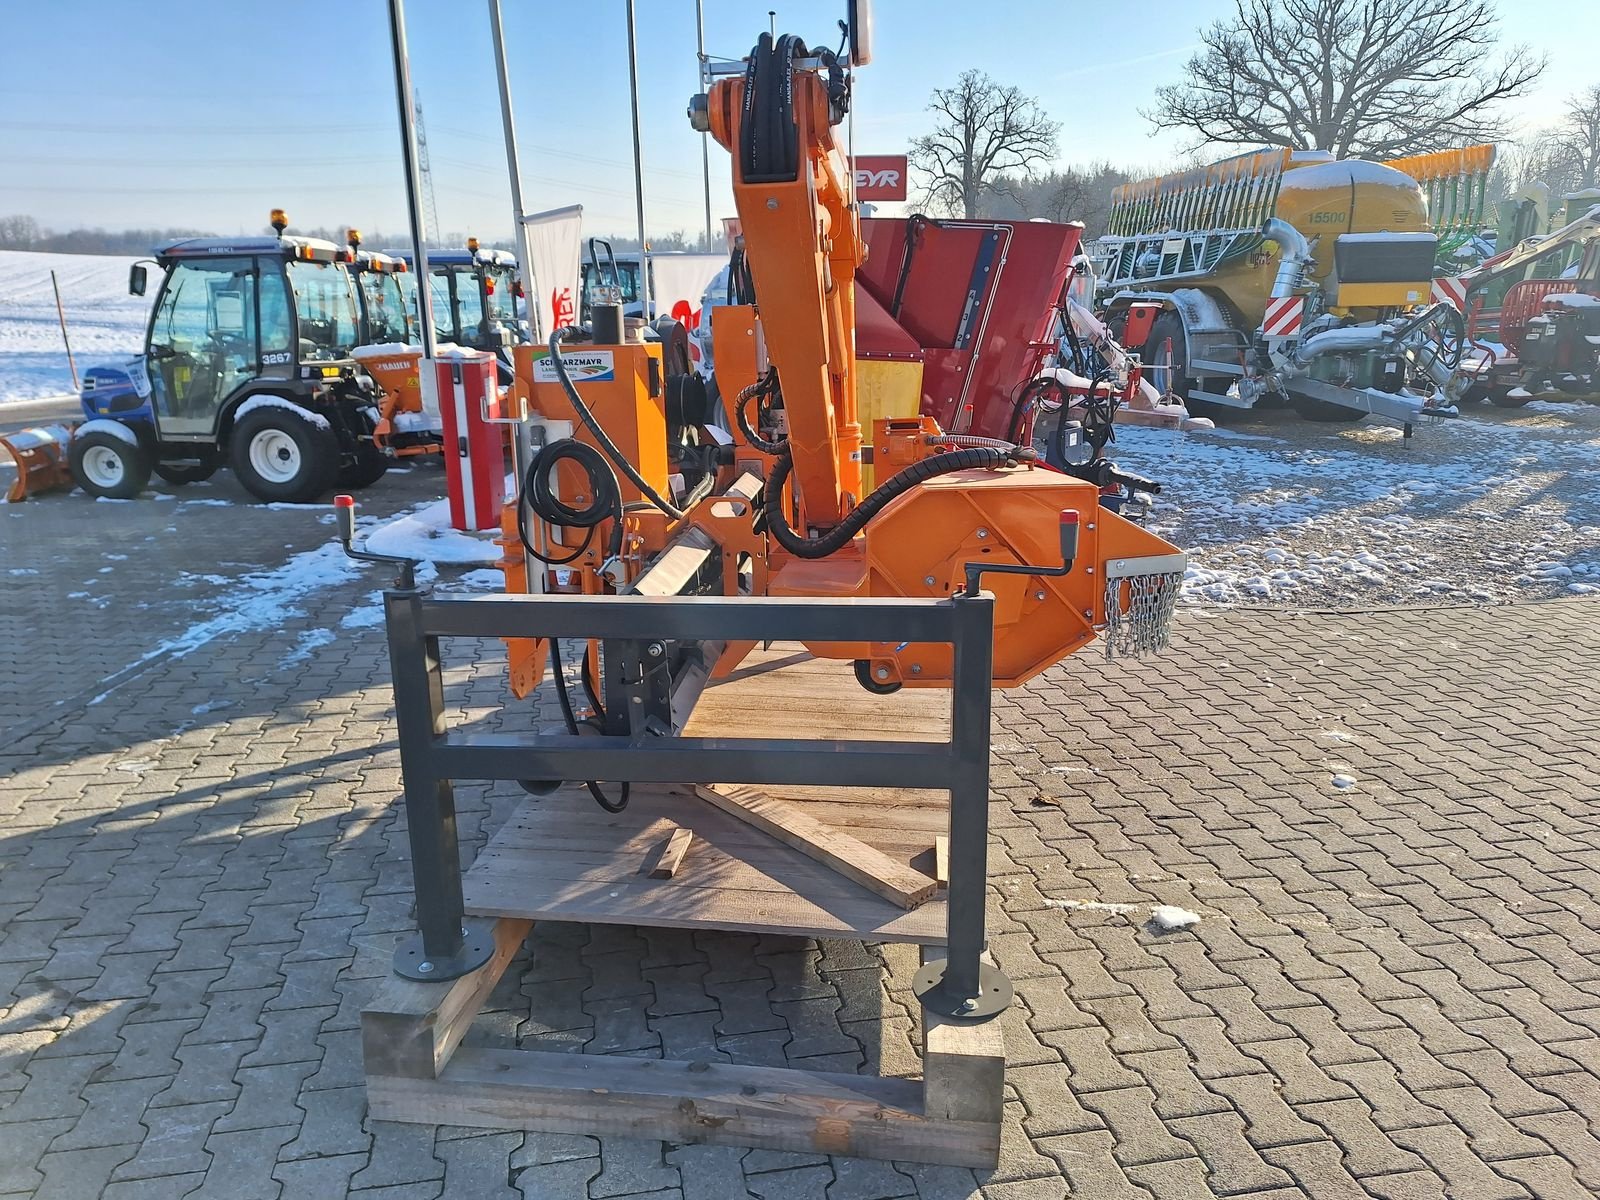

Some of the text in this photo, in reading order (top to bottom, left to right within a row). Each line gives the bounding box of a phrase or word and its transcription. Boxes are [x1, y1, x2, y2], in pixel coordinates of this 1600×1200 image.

[855, 169, 900, 188] EYR
[1308, 211, 1346, 224] 15500
[969, 291, 975, 300] 4
[963, 312, 969, 321] 3
[957, 333, 963, 341] 2
[262, 352, 291, 365] 3267
[540, 358, 602, 366] SCARZMAYR
